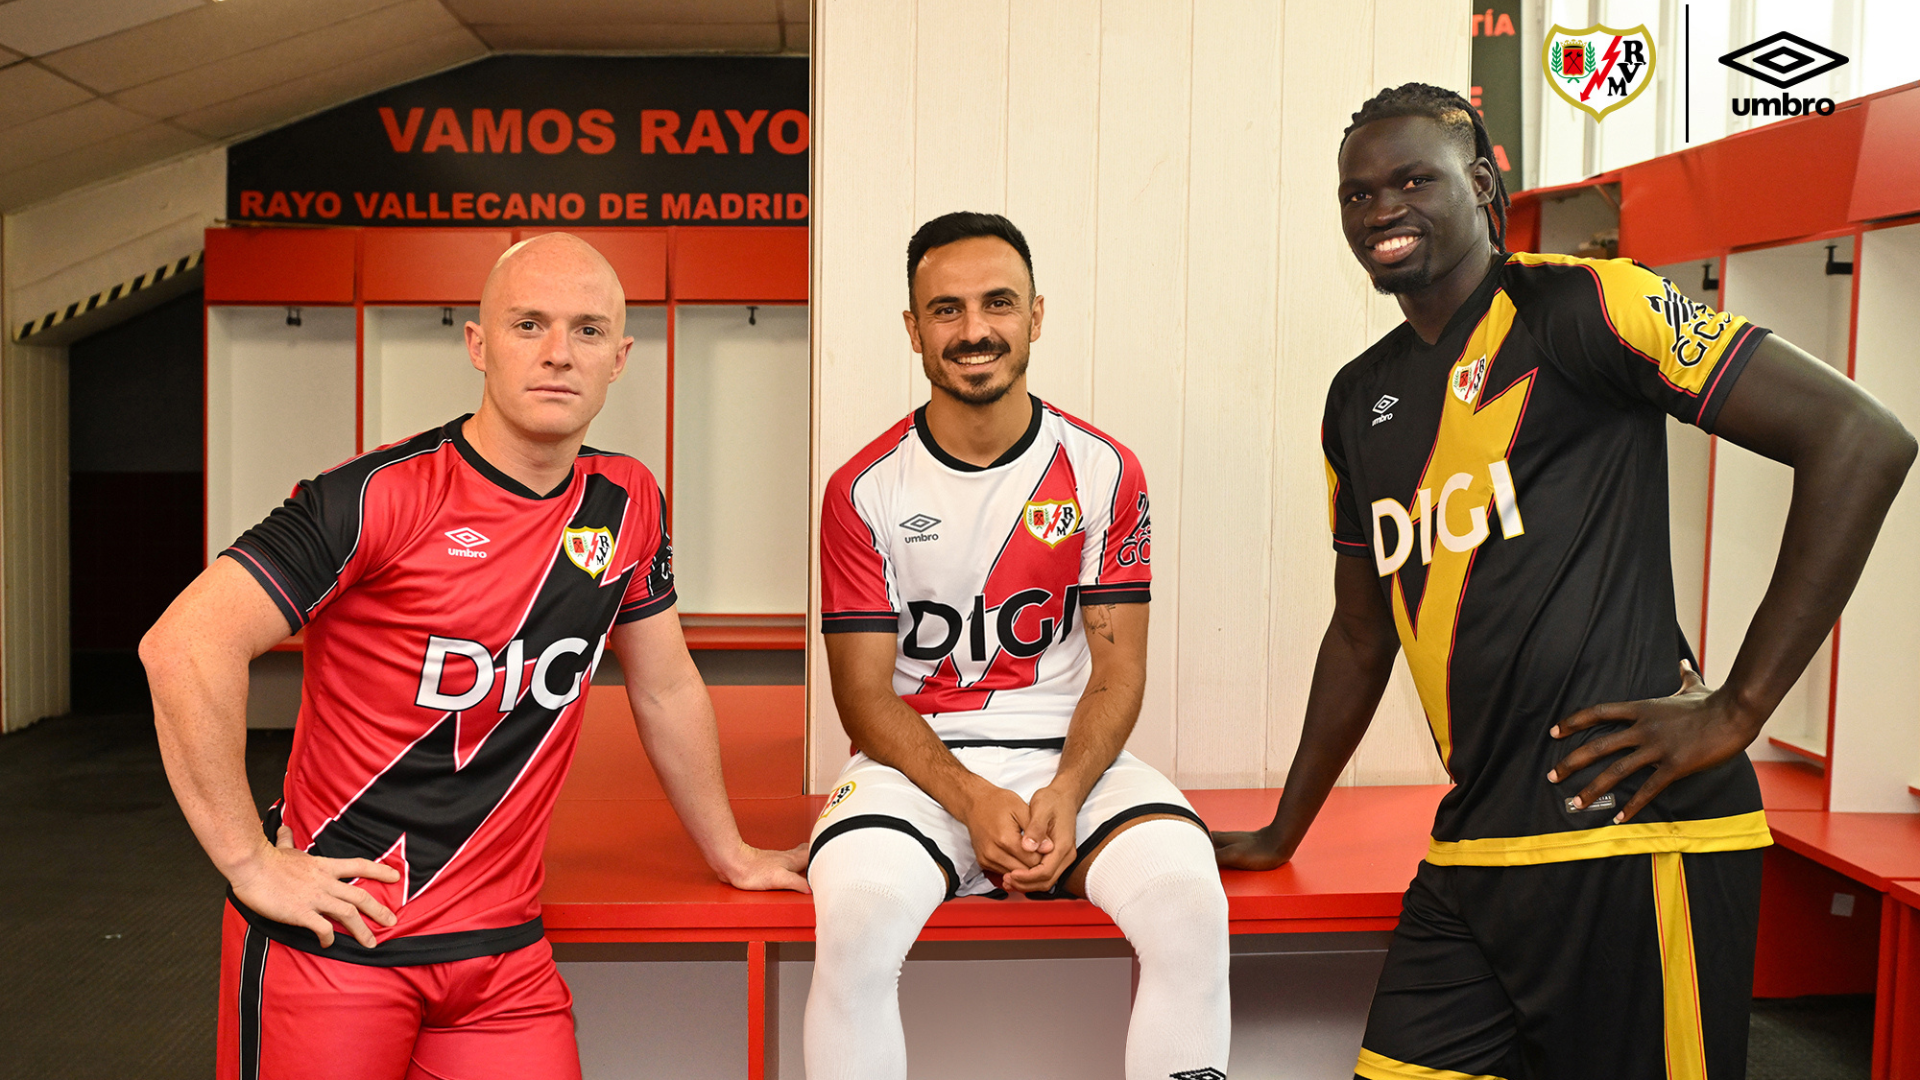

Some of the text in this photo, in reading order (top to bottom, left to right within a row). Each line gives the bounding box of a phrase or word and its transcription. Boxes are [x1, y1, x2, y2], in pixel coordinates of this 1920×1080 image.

[378, 107, 810, 154] VAMOS RAYO
[240, 190, 810, 220] RAYO VALLECANO DE MADRID
[1371, 459, 1525, 577] DIGI
[448, 547, 488, 559] umbro
[904, 533, 939, 544] umbro
[902, 585, 1080, 662] DIGI
